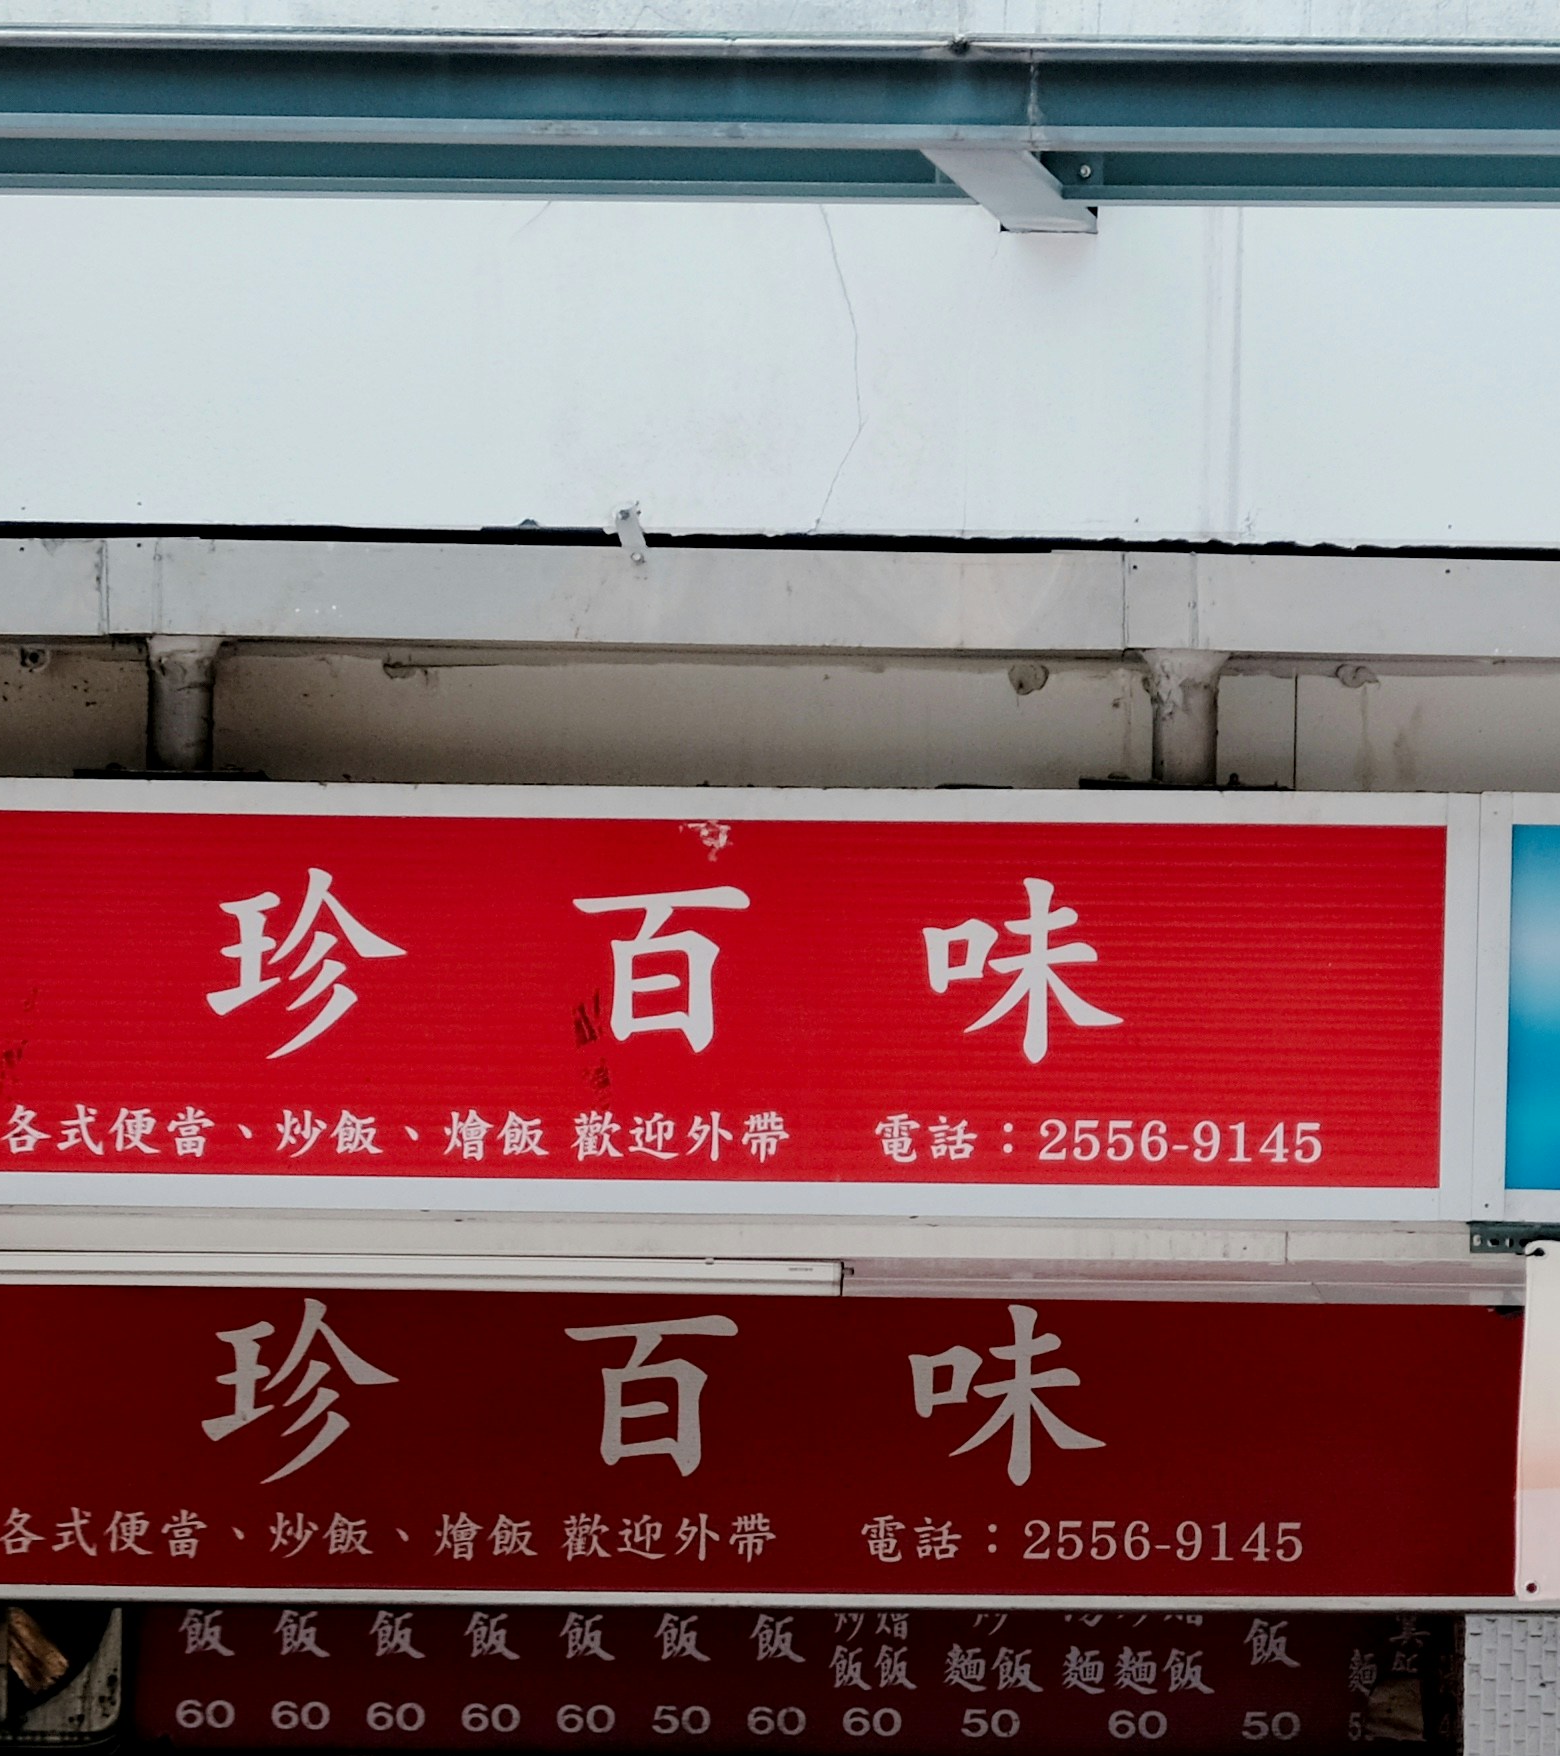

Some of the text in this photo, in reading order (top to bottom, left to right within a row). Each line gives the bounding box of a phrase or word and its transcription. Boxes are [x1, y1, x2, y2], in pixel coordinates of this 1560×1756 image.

[206, 867, 1122, 1062] 珍百味
[570, 1110, 789, 1163] 歡迎外帶
[201, 1297, 1107, 1487] 珍百味
[563, 1513, 777, 1564] 歡迎外帶
[175, 1700, 235, 1730] 60
[270, 1701, 331, 1730] 60
[366, 1701, 426, 1731] 60
[461, 1703, 521, 1732] 60
[556, 1704, 616, 1733] 60
[651, 1705, 711, 1735] 50
[747, 1706, 807, 1736] 60
[842, 1707, 902, 1737] 60
[960, 1709, 1021, 1739] 50
[1108, 1710, 1168, 1740] 60
[1242, 1711, 1301, 1741] 50
